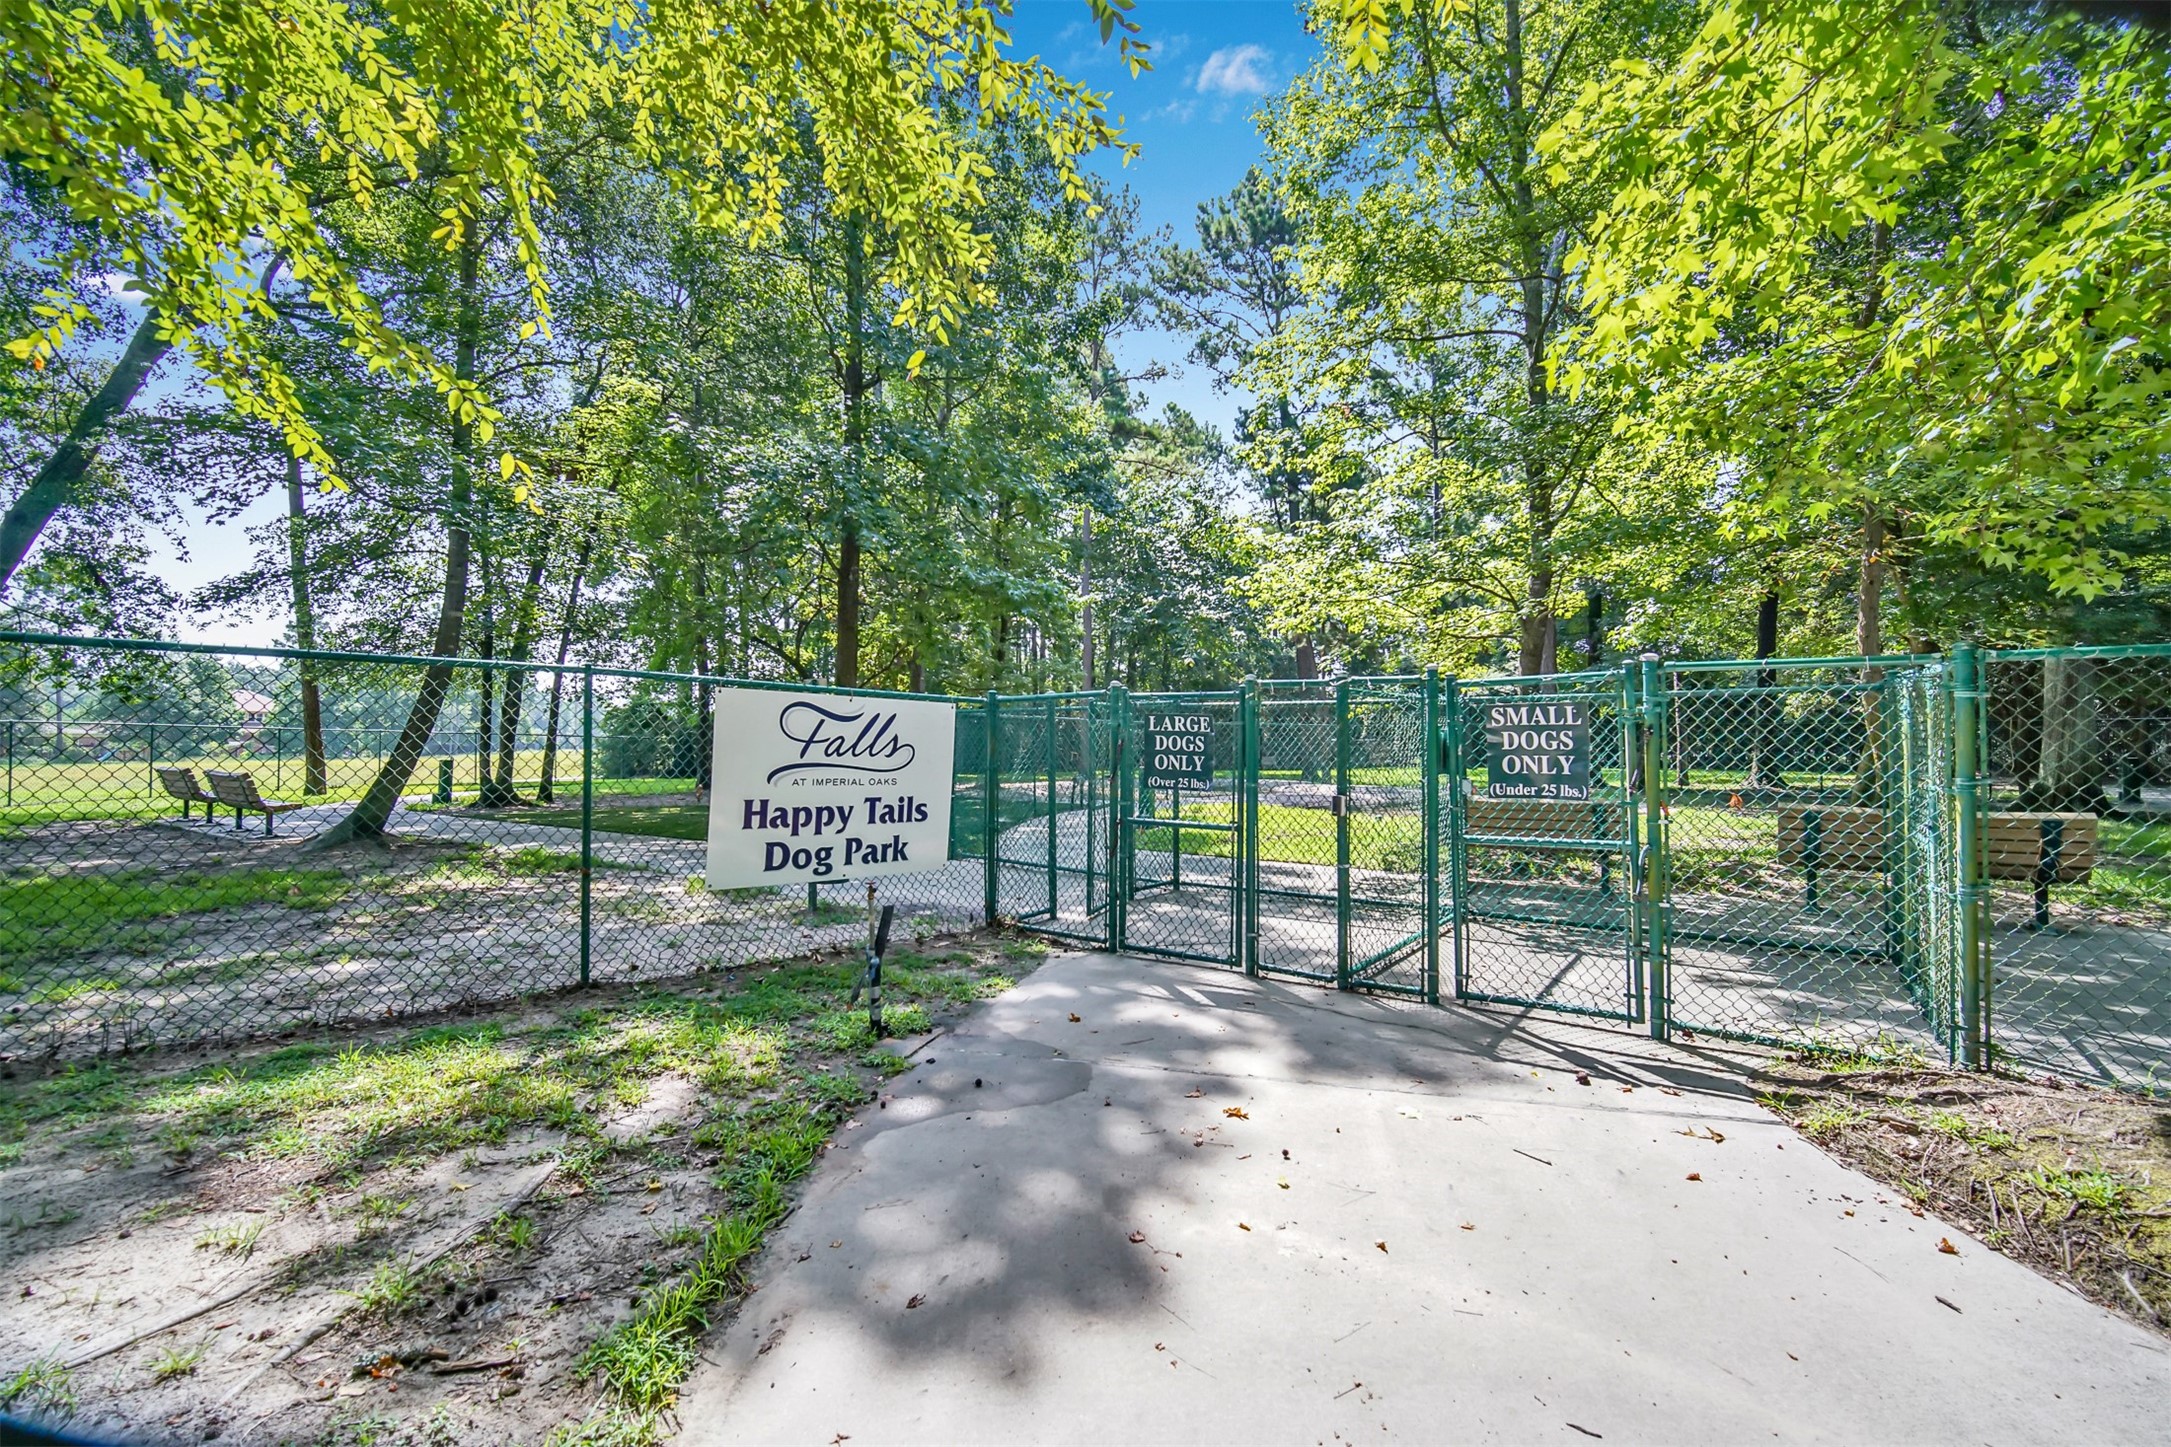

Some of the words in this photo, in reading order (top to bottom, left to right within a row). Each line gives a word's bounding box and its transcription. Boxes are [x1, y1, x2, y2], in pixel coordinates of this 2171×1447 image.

[1148, 715, 1211, 732] LARGE
[1491, 705, 1582, 727] SMALL
[773, 701, 915, 773] Falls
[1154, 735, 1205, 752] DOGS
[1501, 730, 1574, 750] DOGS
[1154, 754, 1205, 771] ONLY
[1501, 755, 1575, 775] ONLY
[792, 778, 807, 786] AT
[812, 778, 864, 786] IMPERIAL
[869, 778, 898, 786] OAKS
[1148, 776, 1176, 787] (Over
[1178, 778, 1189, 788] 25
[1190, 778, 1210, 790] lbs.)
[1490, 783, 1538, 797] (Under
[1541, 784, 1557, 796] 25
[1560, 785, 1587, 800] lbs.)
[741, 799, 854, 837] Happy
[863, 796, 929, 825] Tails
[763, 841, 834, 876] Dog
[843, 835, 909, 866] Park
